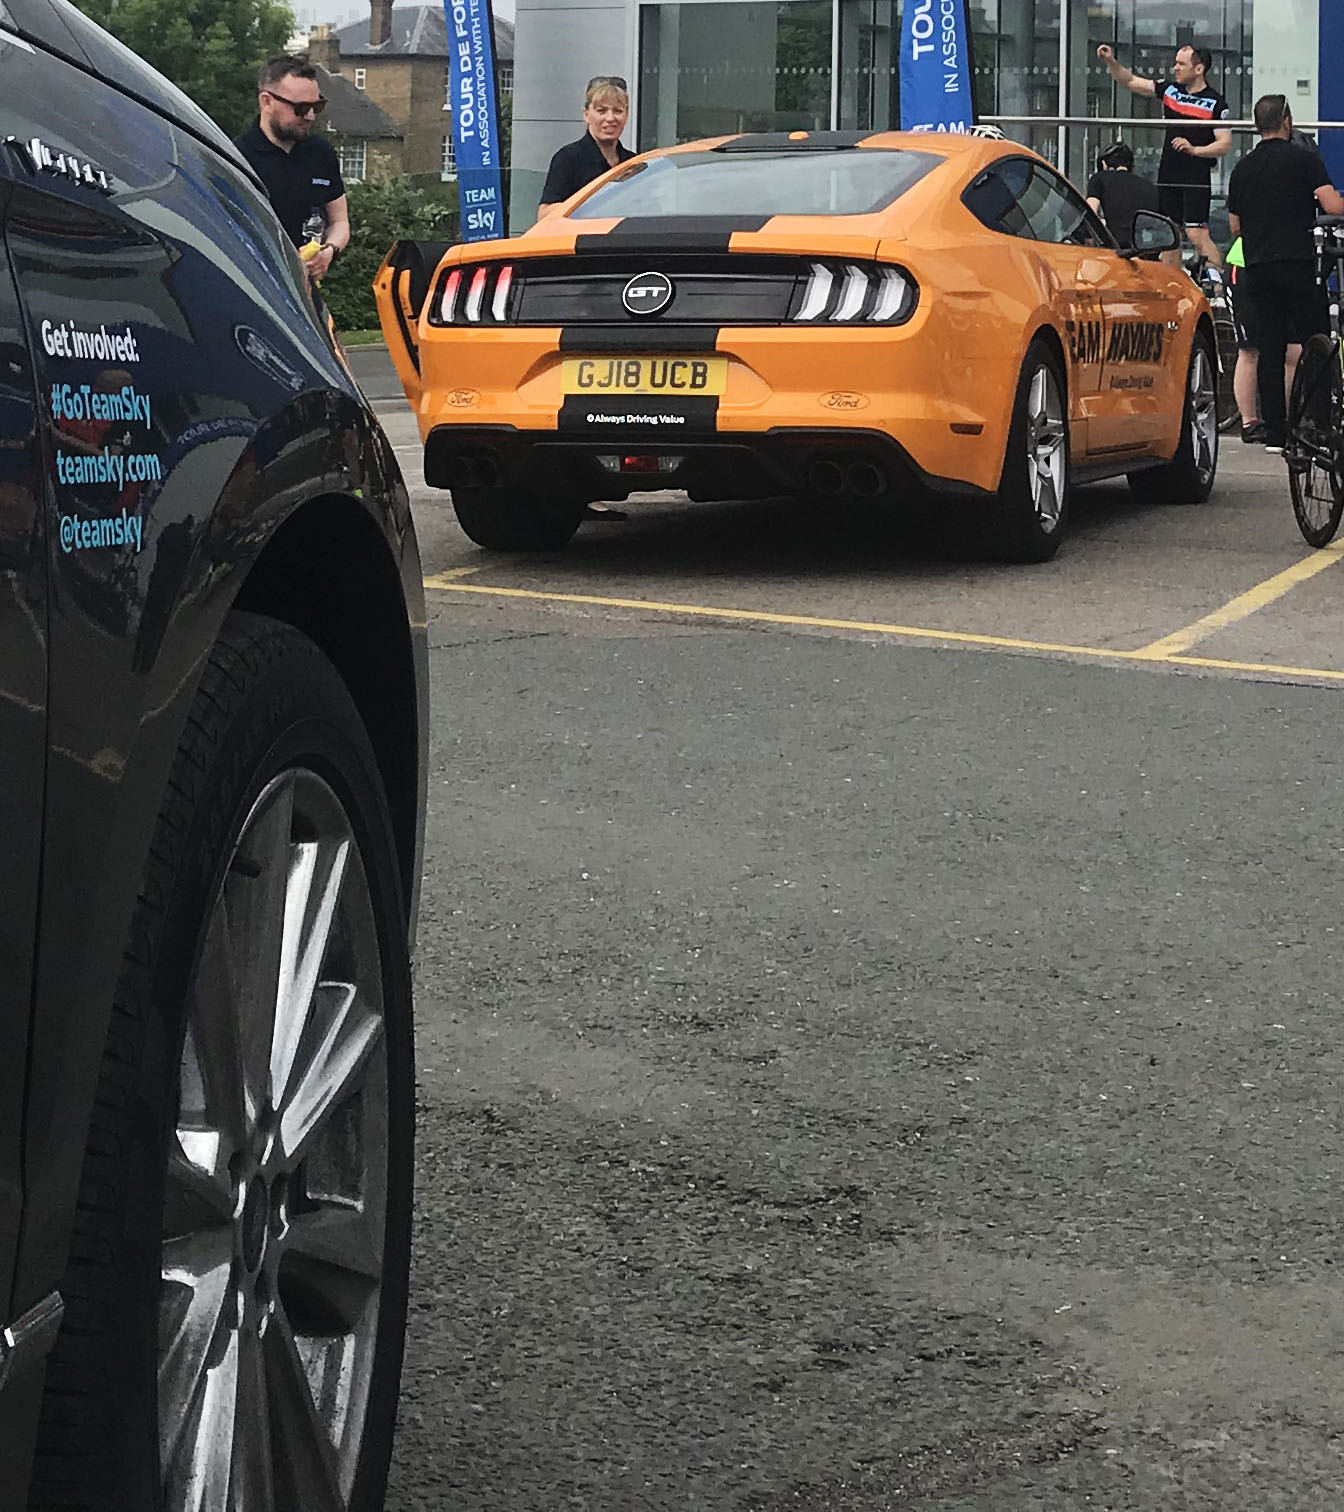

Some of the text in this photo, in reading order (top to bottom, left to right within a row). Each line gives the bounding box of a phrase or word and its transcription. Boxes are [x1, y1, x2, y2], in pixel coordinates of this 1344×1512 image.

[472, 18, 484, 53] WITH
[459, 40, 471, 72] DE
[945, 76, 959, 92] IN
[460, 77, 475, 143] TOUR
[475, 56, 490, 147] ASSOCIATION
[482, 150, 491, 165] IN
[465, 187, 495, 203] TEAM
[468, 209, 495, 231] sky
[628, 286, 666, 298] GT
[41, 319, 140, 362] Get involved:
[578, 361, 708, 389] GJ18 UCB
[51, 383, 151, 430] #GoTeamSky
[827, 394, 860, 409] Ford
[595, 414, 685, 425] Always Driving Value
[56, 446, 162, 491] teamsky.com
[60, 508, 143, 553] @teamsky
